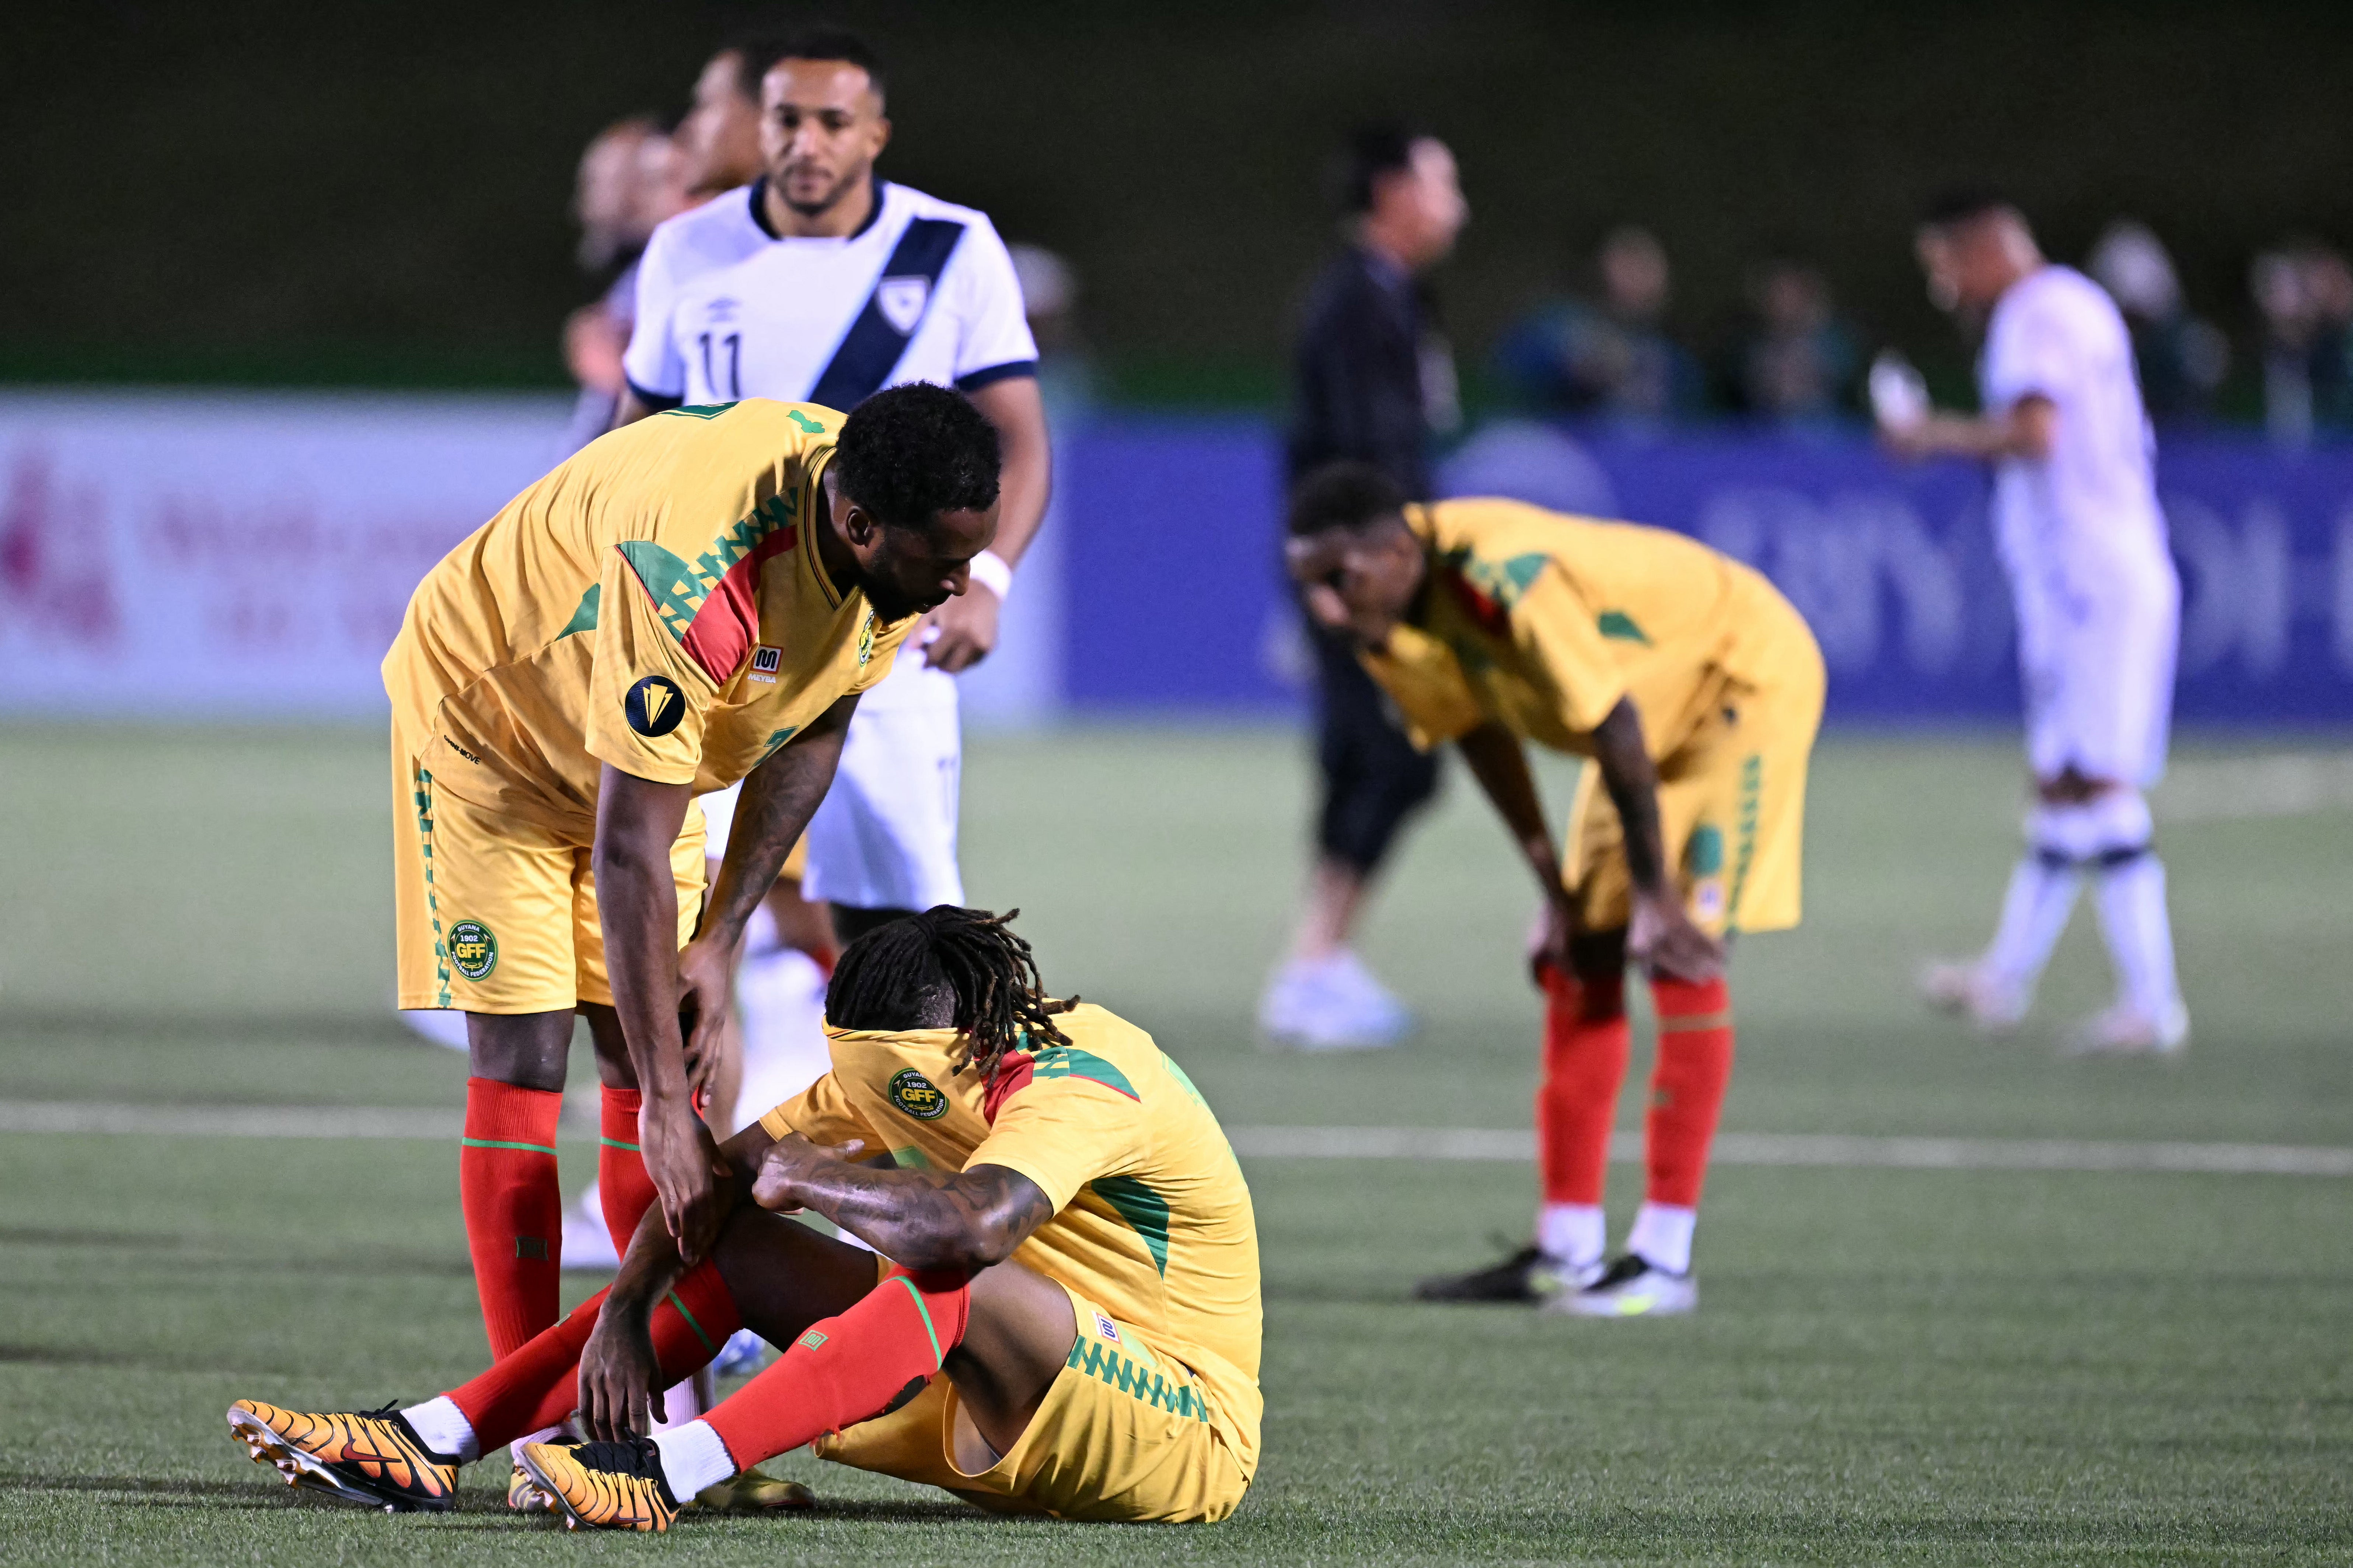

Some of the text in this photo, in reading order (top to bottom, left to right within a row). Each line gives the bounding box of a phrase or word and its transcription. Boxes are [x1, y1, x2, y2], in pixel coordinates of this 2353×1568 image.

[699, 333, 740, 399] 11
[747, 673, 776, 683] MEYBA
[444, 735, 481, 765] OMNI-MOVE
[456, 943, 485, 958] GFF
[451, 952, 493, 977] FOOTBALL FEDERATION
[894, 1095, 944, 1117] FOOTBALL FEDERATION
[901, 1088, 935, 1103] GFF
